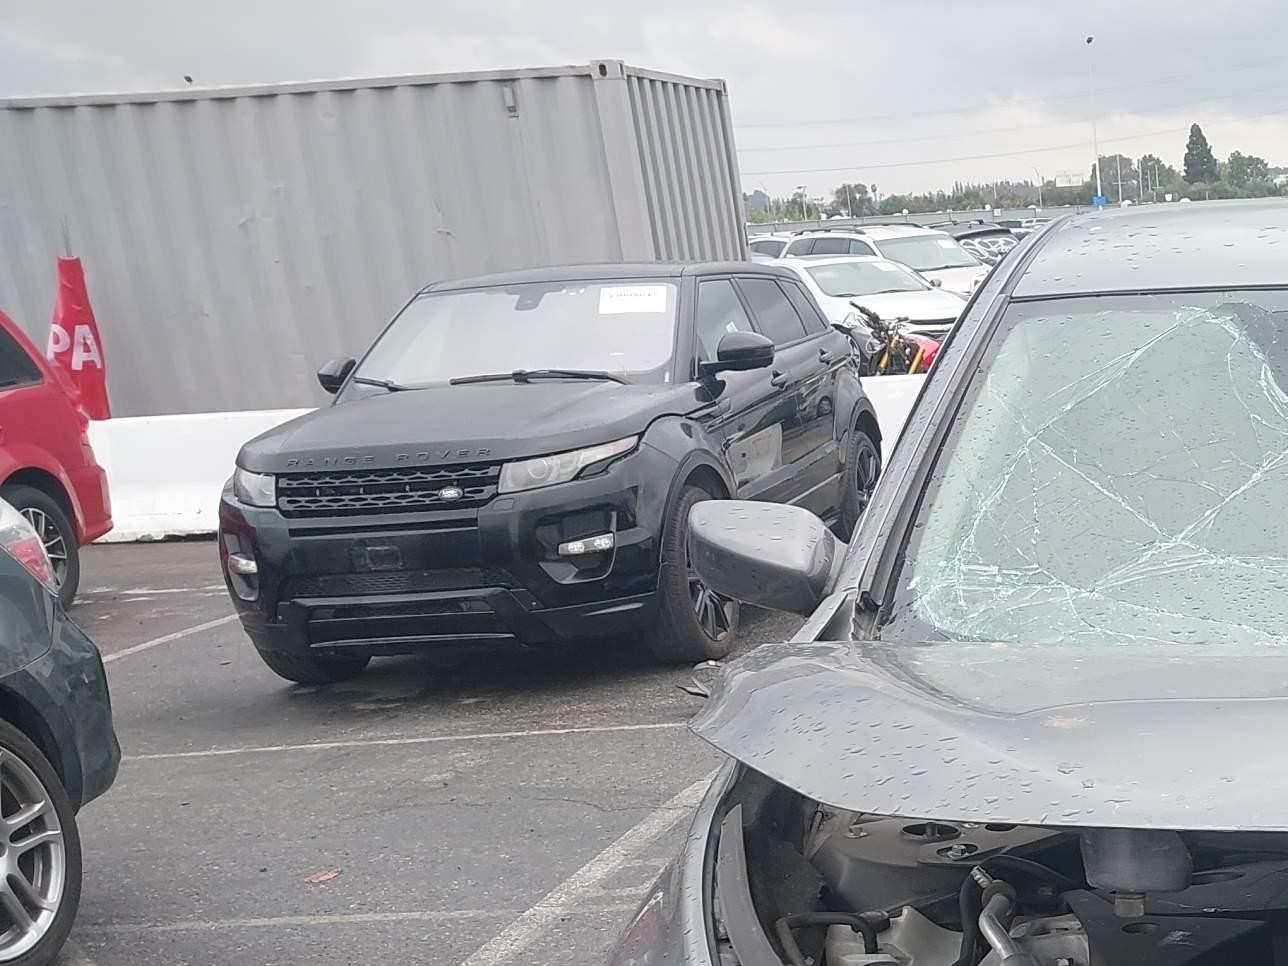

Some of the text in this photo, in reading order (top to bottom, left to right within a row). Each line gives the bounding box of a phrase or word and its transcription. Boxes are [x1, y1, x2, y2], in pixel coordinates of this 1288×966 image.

[46, 323, 102, 370] PA
[287, 447, 491, 468] RANGE ROVER
